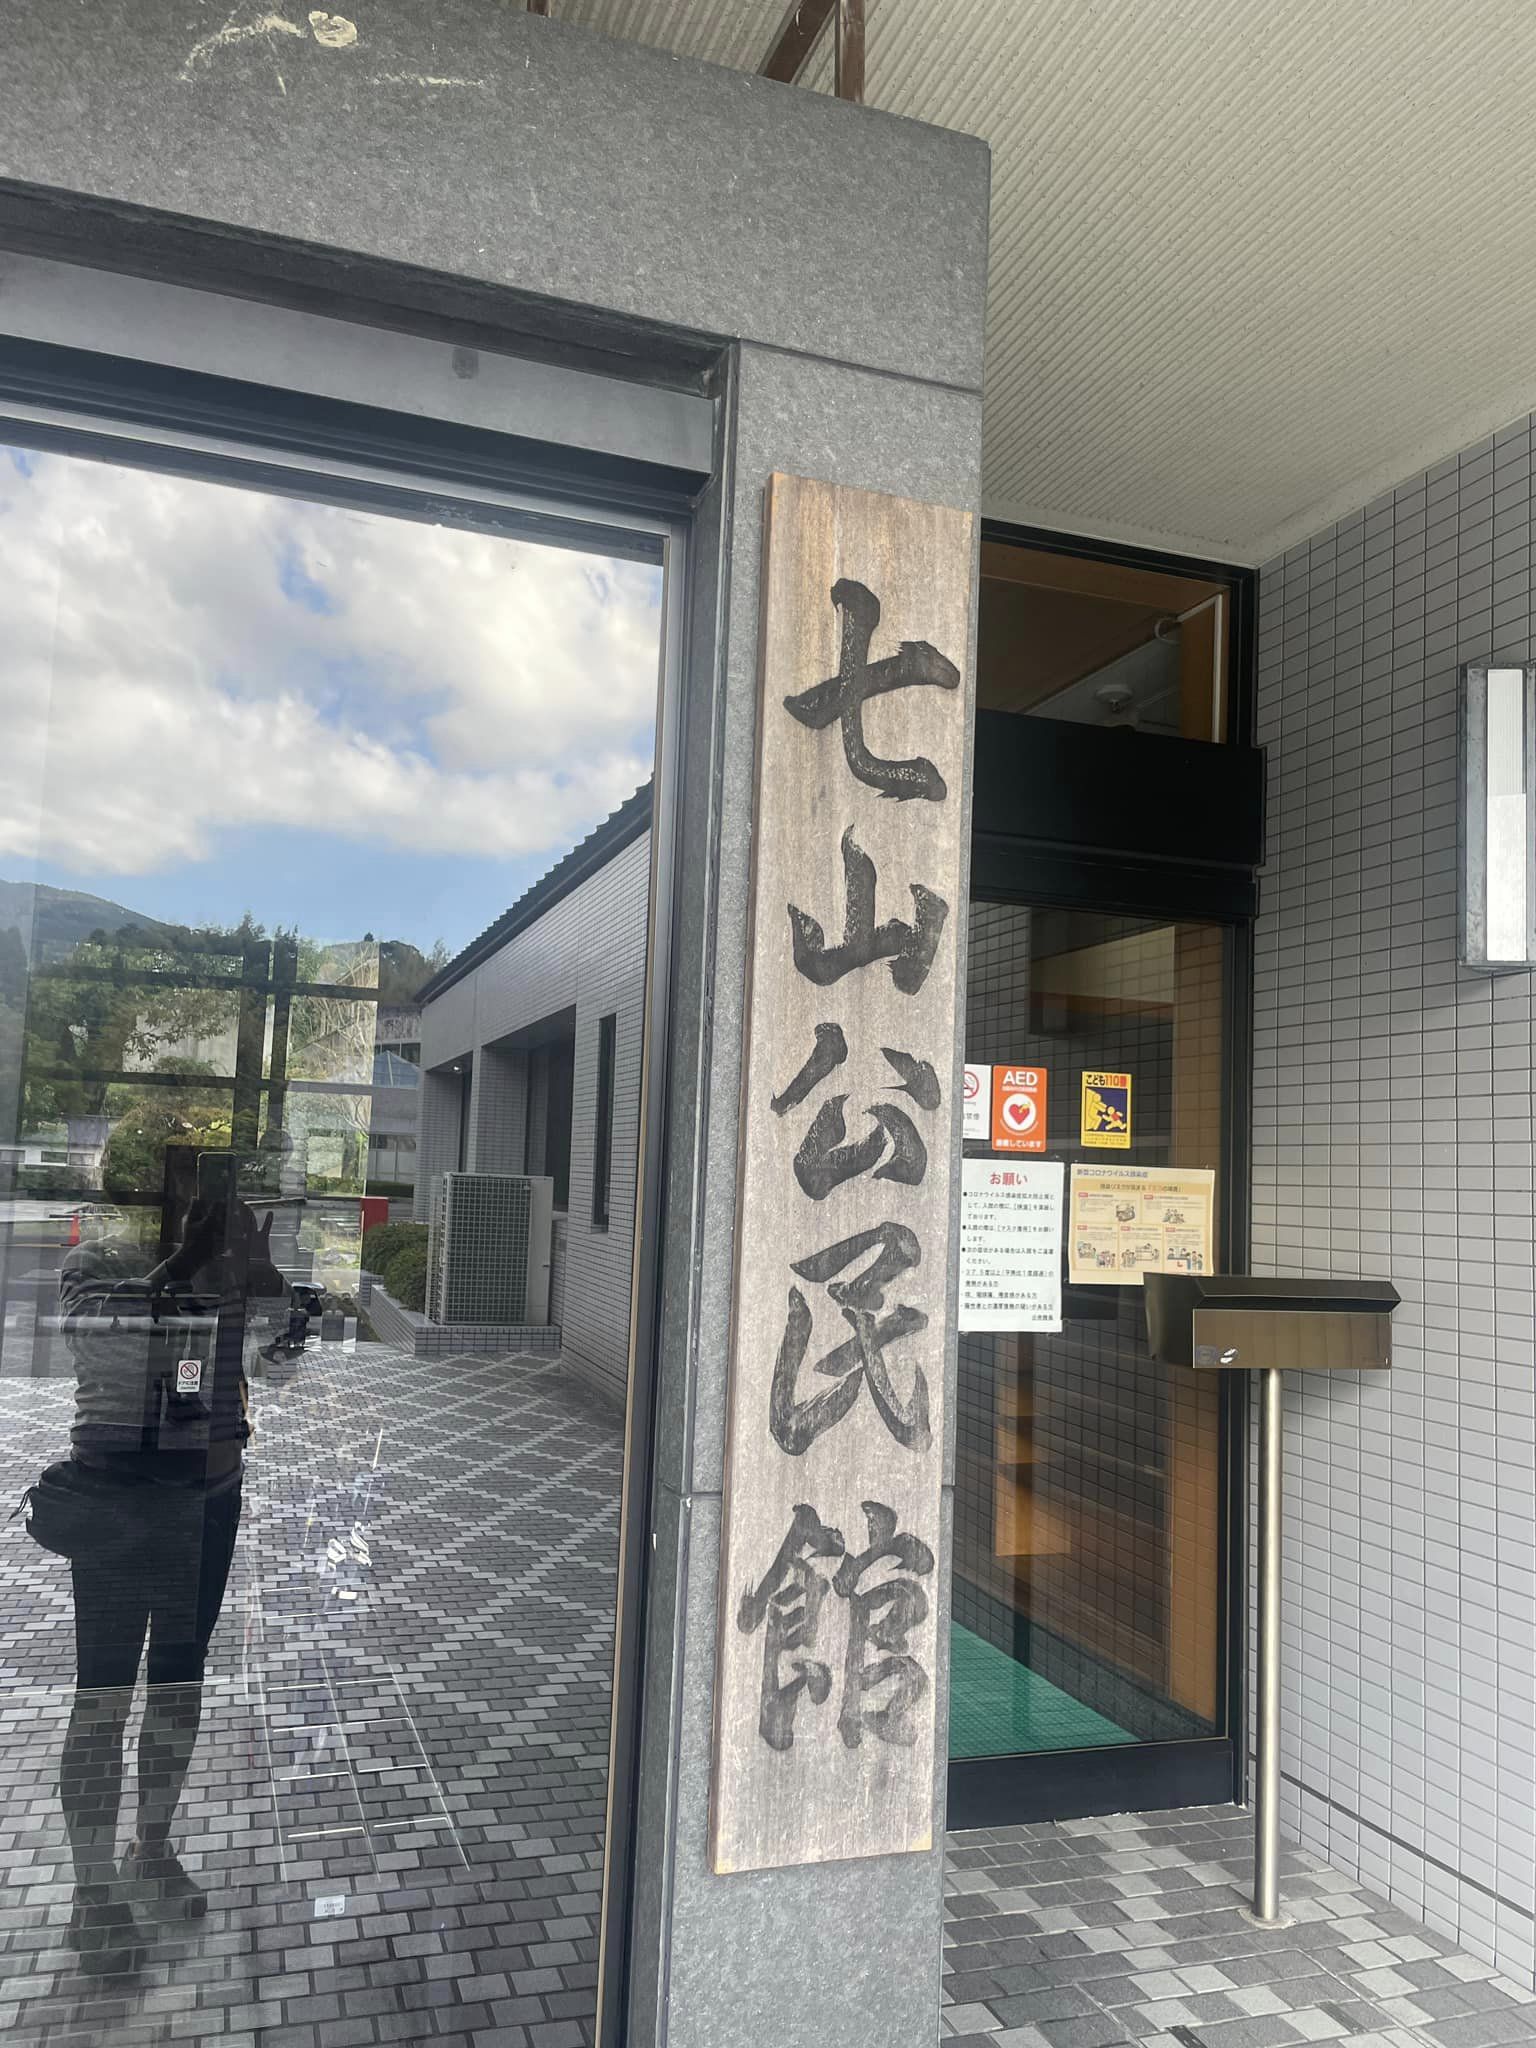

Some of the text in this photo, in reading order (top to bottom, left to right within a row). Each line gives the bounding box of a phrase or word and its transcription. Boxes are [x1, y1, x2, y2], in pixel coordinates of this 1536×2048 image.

[1002, 1070, 1038, 1086] AED
[737, 577, 961, 1750] 七山公民館
[990, 1172, 1028, 1185] お願い
